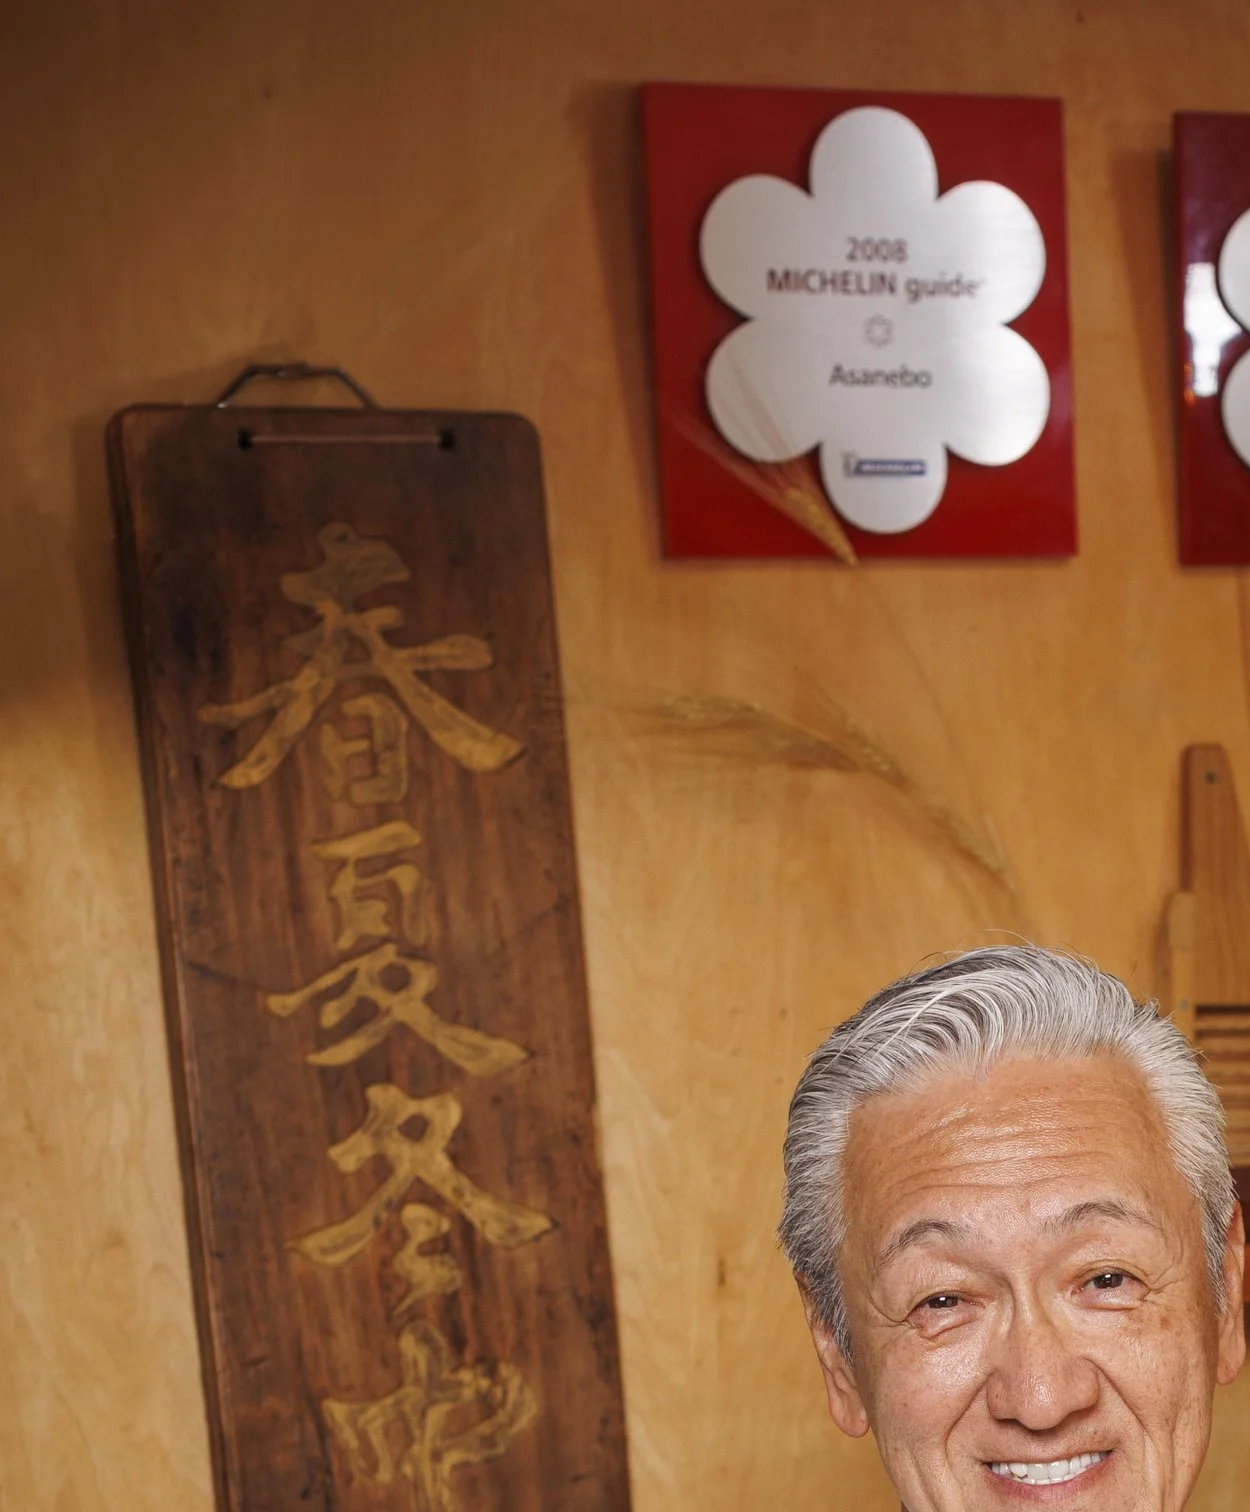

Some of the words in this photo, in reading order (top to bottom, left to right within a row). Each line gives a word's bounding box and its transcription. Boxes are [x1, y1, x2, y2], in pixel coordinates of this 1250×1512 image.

[846, 236, 909, 263] 2008
[766, 267, 897, 296] MICHELIN
[828, 363, 933, 389] Asanebo
